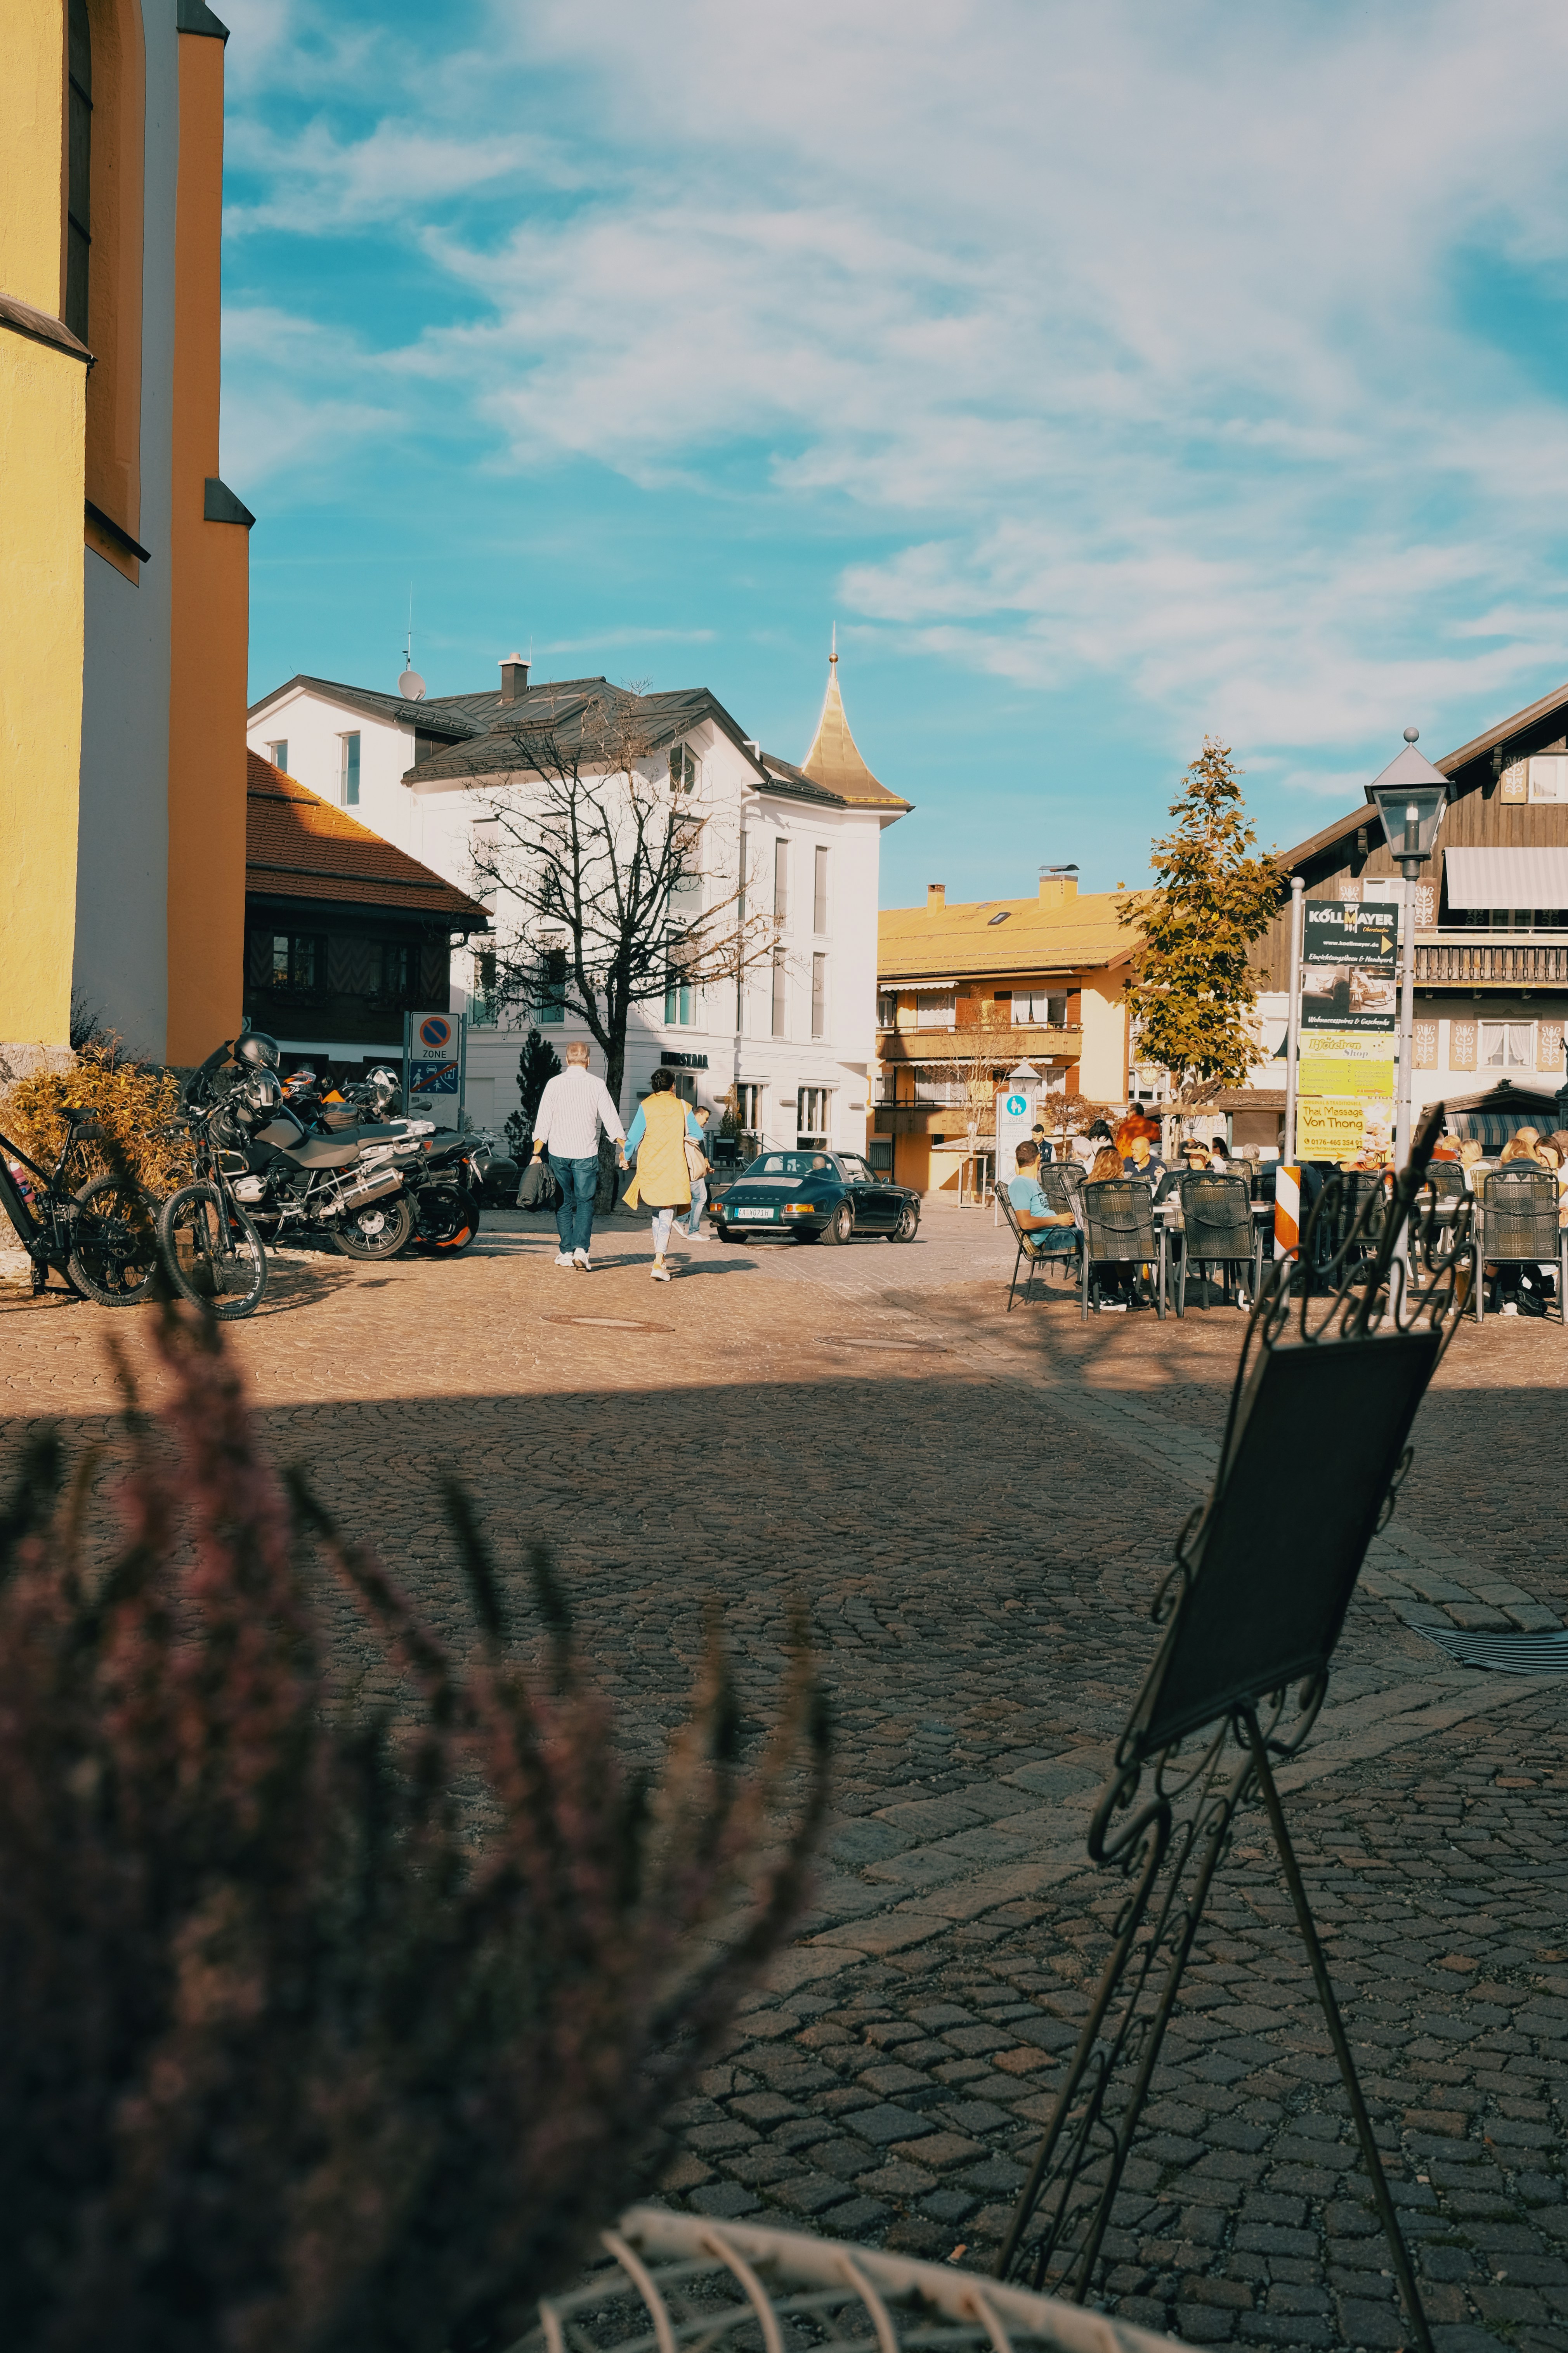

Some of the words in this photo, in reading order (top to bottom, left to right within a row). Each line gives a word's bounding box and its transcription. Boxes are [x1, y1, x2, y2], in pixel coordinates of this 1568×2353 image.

[1308, 953, 1358, 963] Einrichtungsideen
[1365, 956, 1393, 964] Handwerk
[1308, 1016, 1354, 1024] Wohnaccessoires
[1309, 1037, 1362, 1051] Pfötchen
[423, 1050, 446, 1058] ZONE
[1343, 1048, 1369, 1058] Shop
[1303, 1107, 1321, 1115] Thai
[1324, 1107, 1363, 1117] Massage
[1303, 1117, 1325, 1126] Von
[1327, 1118, 1363, 1130] Thong
